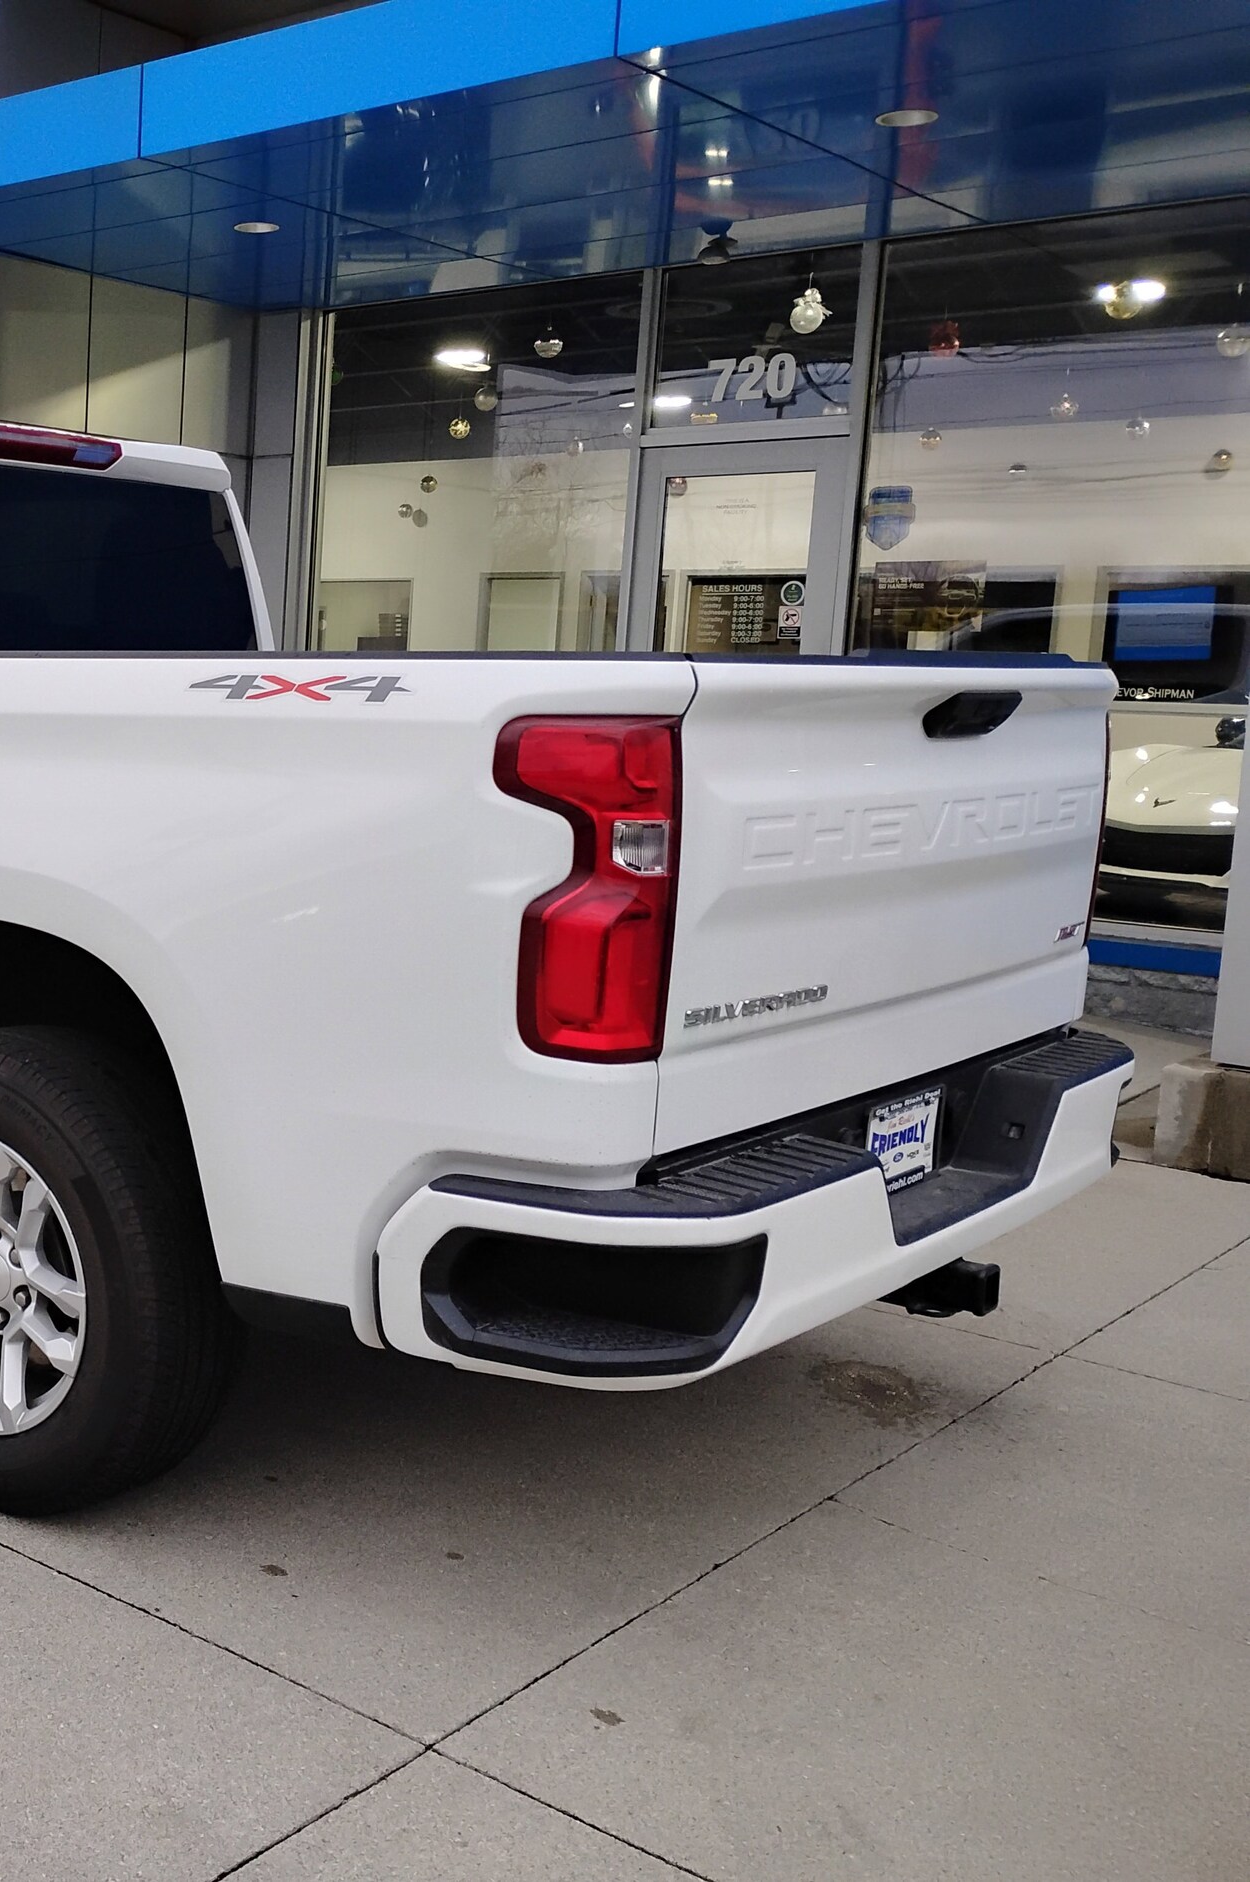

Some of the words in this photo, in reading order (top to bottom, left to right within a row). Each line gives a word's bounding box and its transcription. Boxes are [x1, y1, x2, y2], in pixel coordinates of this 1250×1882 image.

[708, 353, 796, 402] 720
[1117, 687, 1144, 697] EVOR
[1147, 687, 1195, 699] SHIPMAN
[743, 784, 1100, 870] CHEVROLET
[684, 984, 828, 1028] SILVERADO
[870, 1113, 930, 1157] FRIENDLY
[887, 1172, 923, 1192] riehl.com
